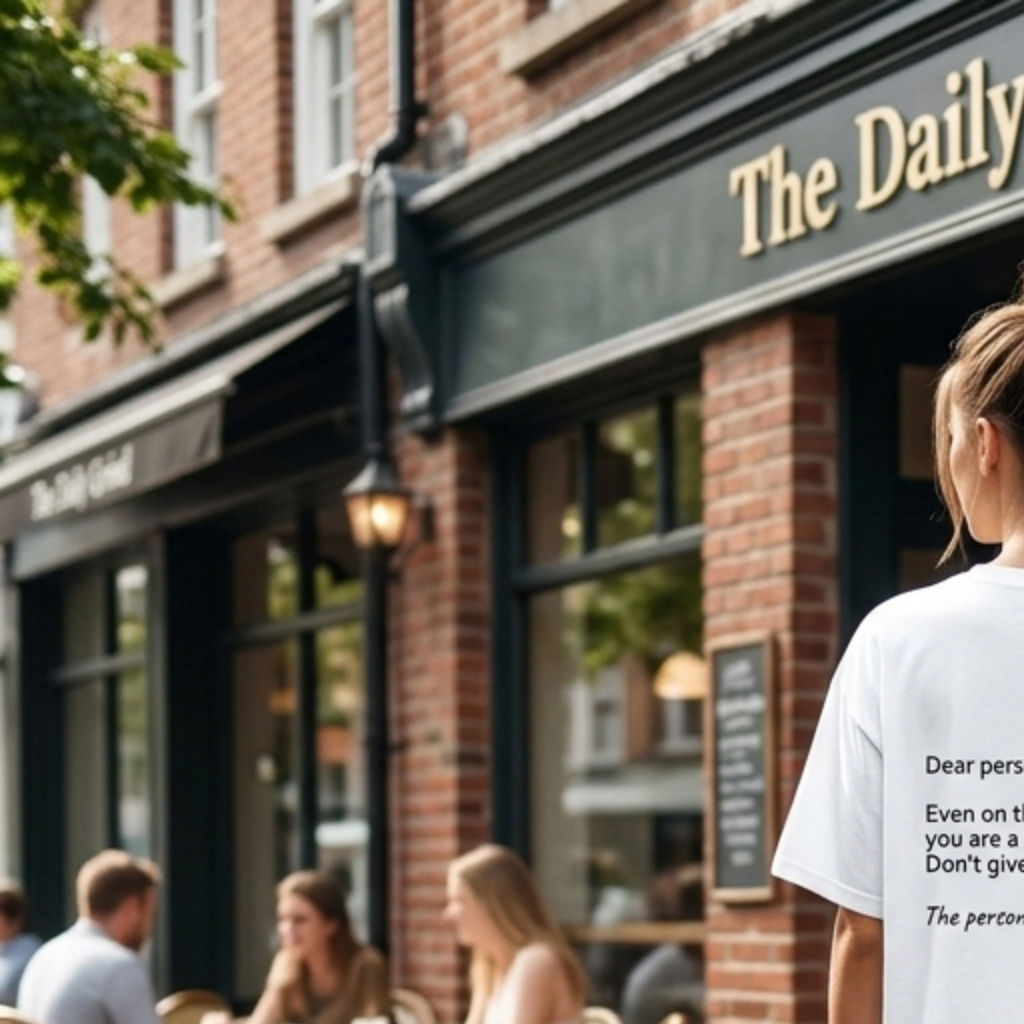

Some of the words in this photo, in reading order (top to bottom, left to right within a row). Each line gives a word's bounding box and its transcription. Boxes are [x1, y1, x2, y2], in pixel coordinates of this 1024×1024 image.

[729, 144, 839, 258] The
[925, 755, 975, 775] Dear
[925, 803, 975, 823] Even
[981, 808, 1007, 823] on
[925, 833, 963, 853] you
[969, 833, 1002, 848] are
[1007, 833, 1019, 848] a
[925, 854, 982, 874] Don't
[926, 905, 961, 927] The
